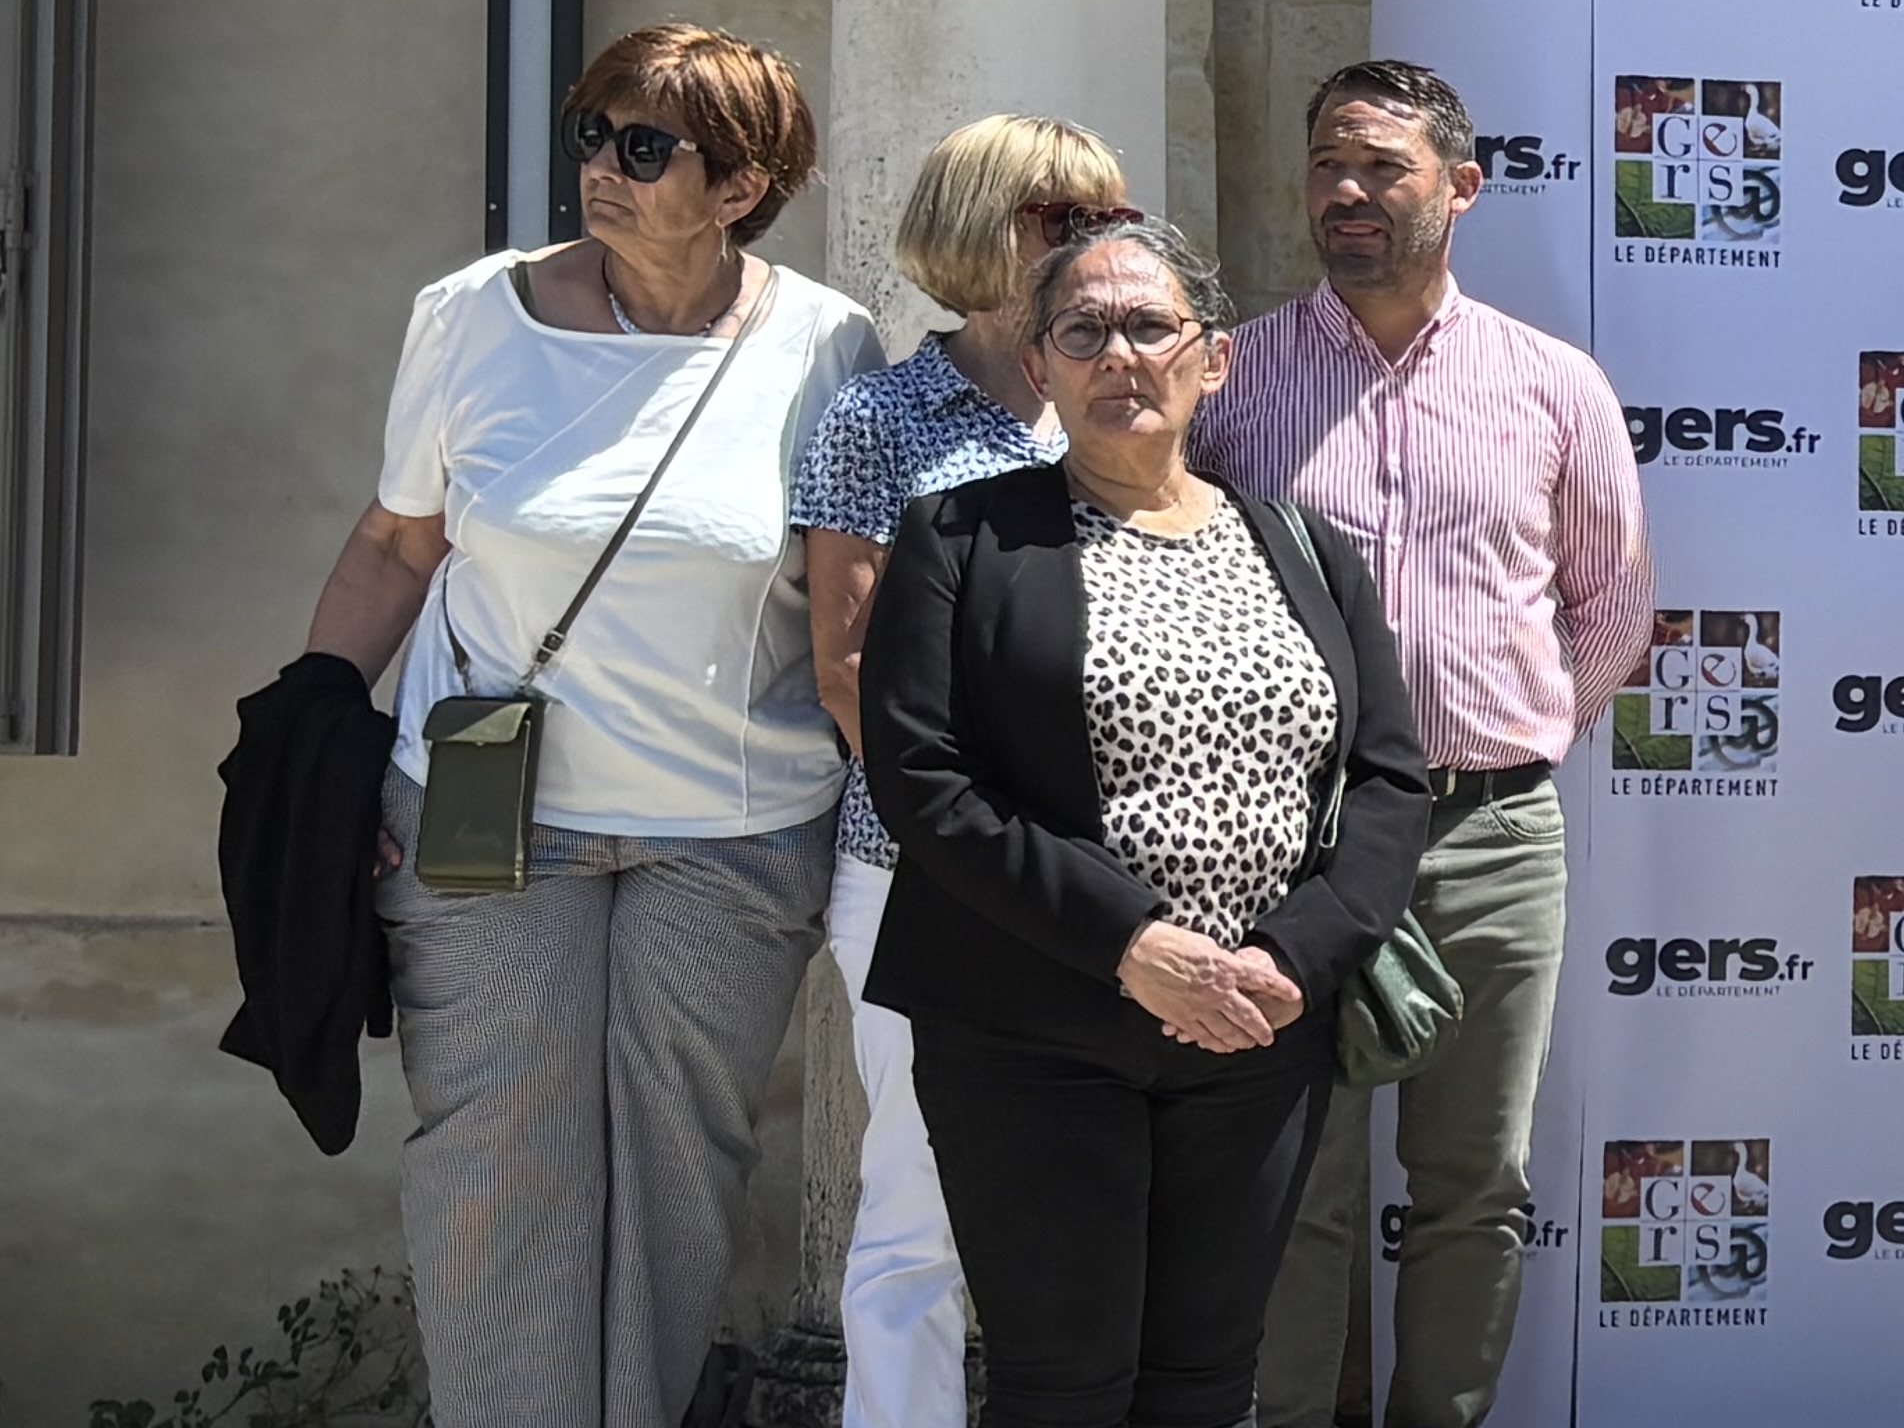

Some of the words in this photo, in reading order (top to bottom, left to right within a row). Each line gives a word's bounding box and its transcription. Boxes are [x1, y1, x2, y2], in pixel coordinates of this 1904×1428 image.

[1475, 135, 1581, 180] rs.fr
[1615, 246, 1634, 263] LE
[1645, 245, 1780, 268] DÉPARTEMENT
[1624, 405, 1821, 463] gers.fr
[1859, 518, 1878, 535] LE
[1612, 778, 1631, 795] LE
[1641, 774, 1777, 797] DÉPARTEMENT
[1605, 937, 1814, 996] gers.fr
[1851, 1043, 1870, 1060] LE
[1600, 1310, 1619, 1328] LE
[1630, 1305, 1767, 1328] DÉPARTEMENT
